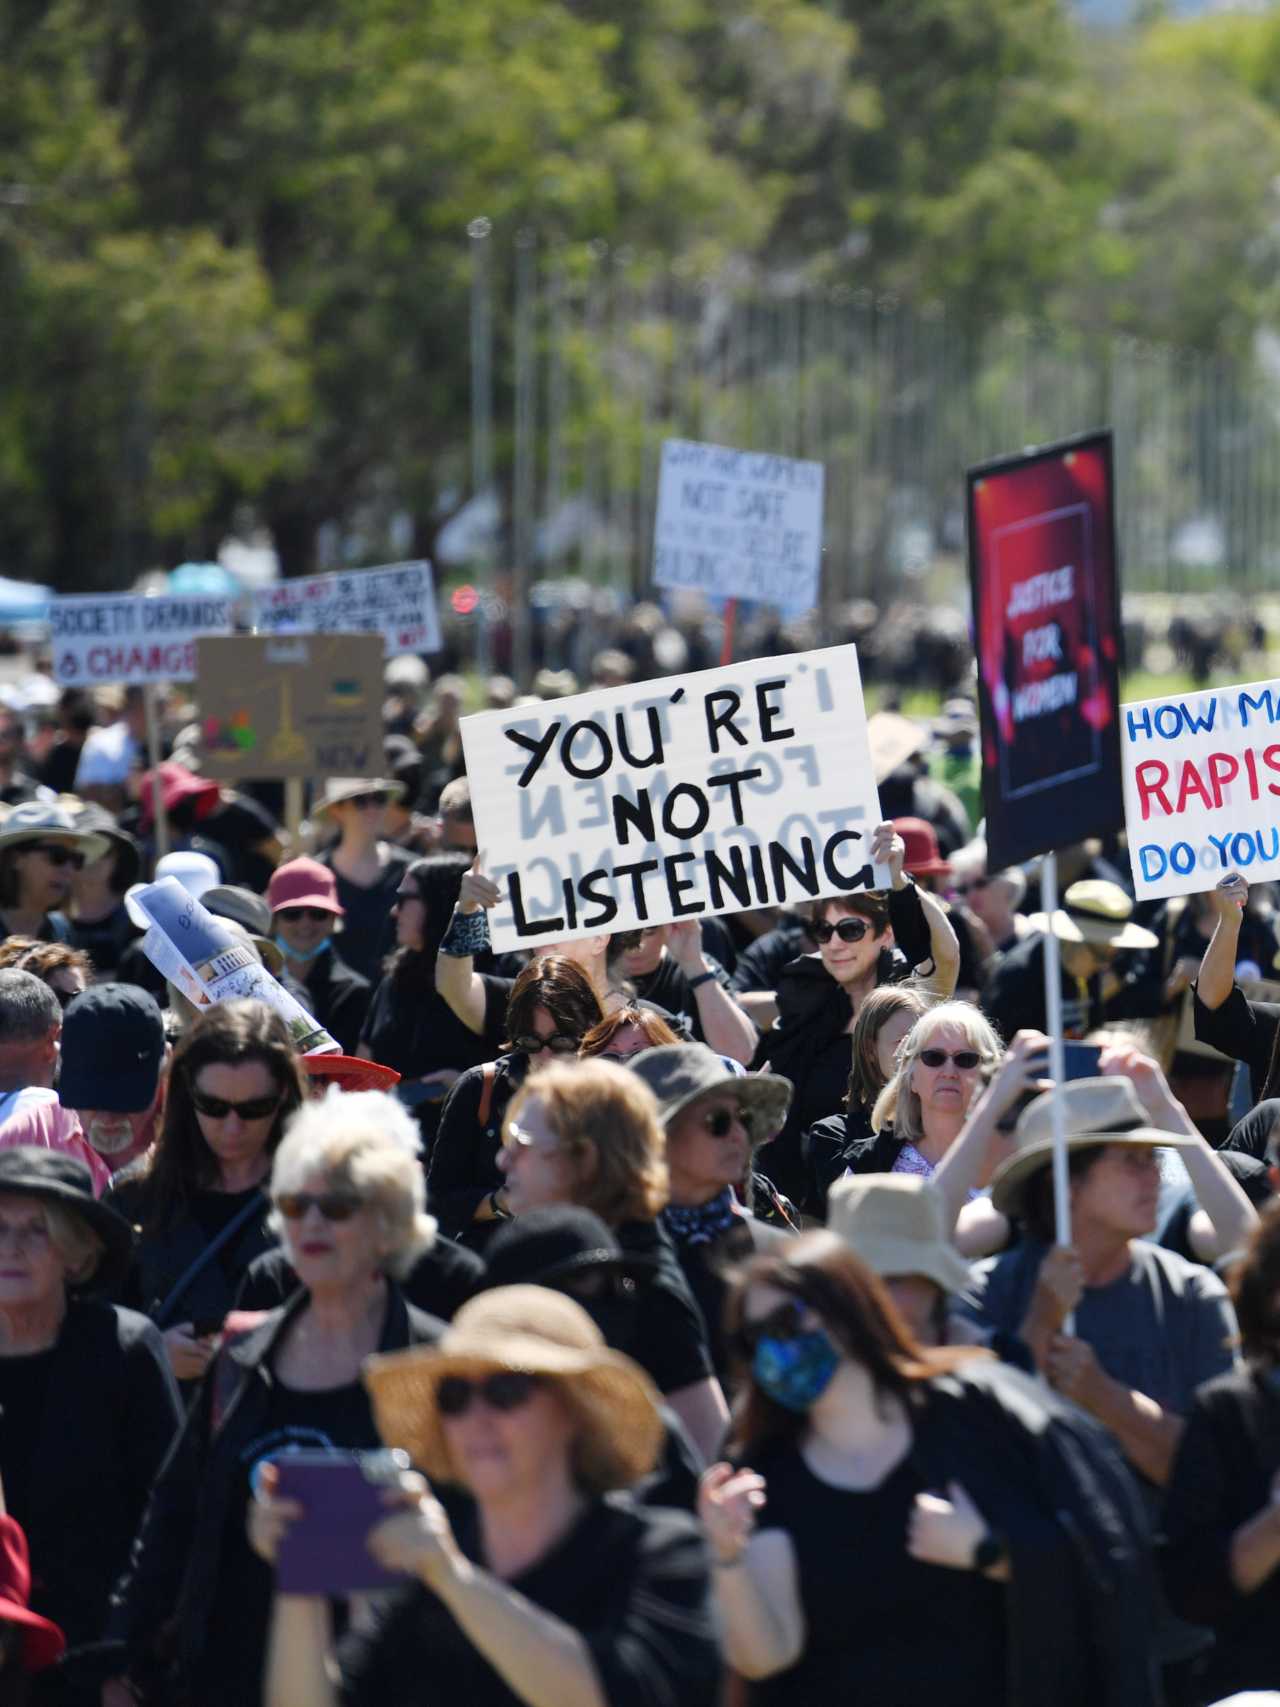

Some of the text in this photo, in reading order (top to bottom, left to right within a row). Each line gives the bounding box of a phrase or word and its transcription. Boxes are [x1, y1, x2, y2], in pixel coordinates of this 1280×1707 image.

[1022, 622, 1064, 668] FOR
[1012, 671, 1079, 723] WOMEN
[1127, 697, 1217, 742] HOW
[505, 679, 795, 788] YOU'RE
[612, 767, 762, 845] NOT
[1138, 841, 1196, 882] DO
[1207, 826, 1280, 868] YOU
[507, 829, 876, 938] LISTENING
